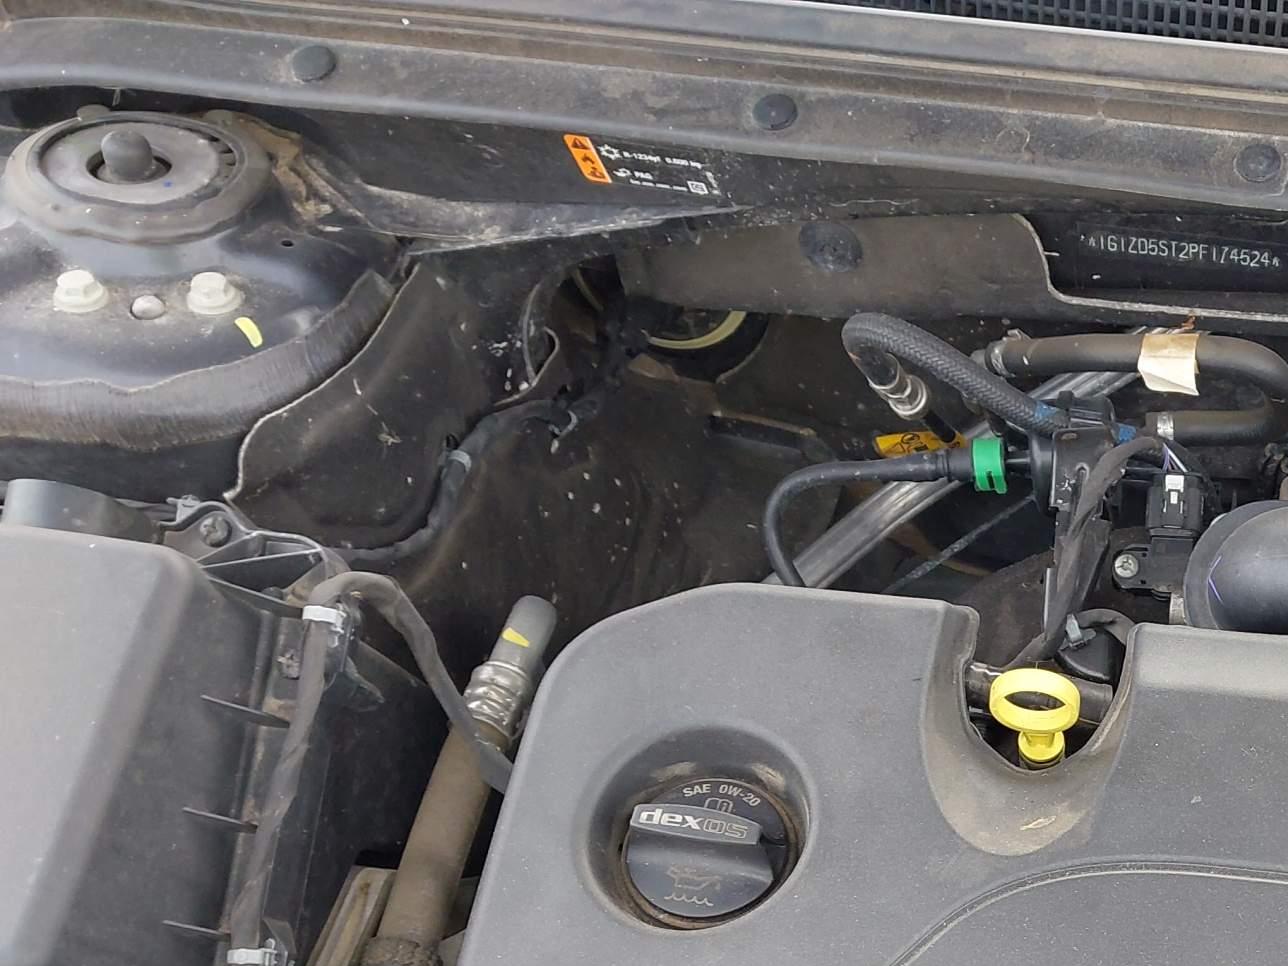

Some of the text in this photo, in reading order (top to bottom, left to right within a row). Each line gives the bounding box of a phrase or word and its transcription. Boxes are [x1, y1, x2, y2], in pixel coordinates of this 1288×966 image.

[682, 783, 761, 807] SAE 0W-20
[638, 808, 749, 839] dexos
